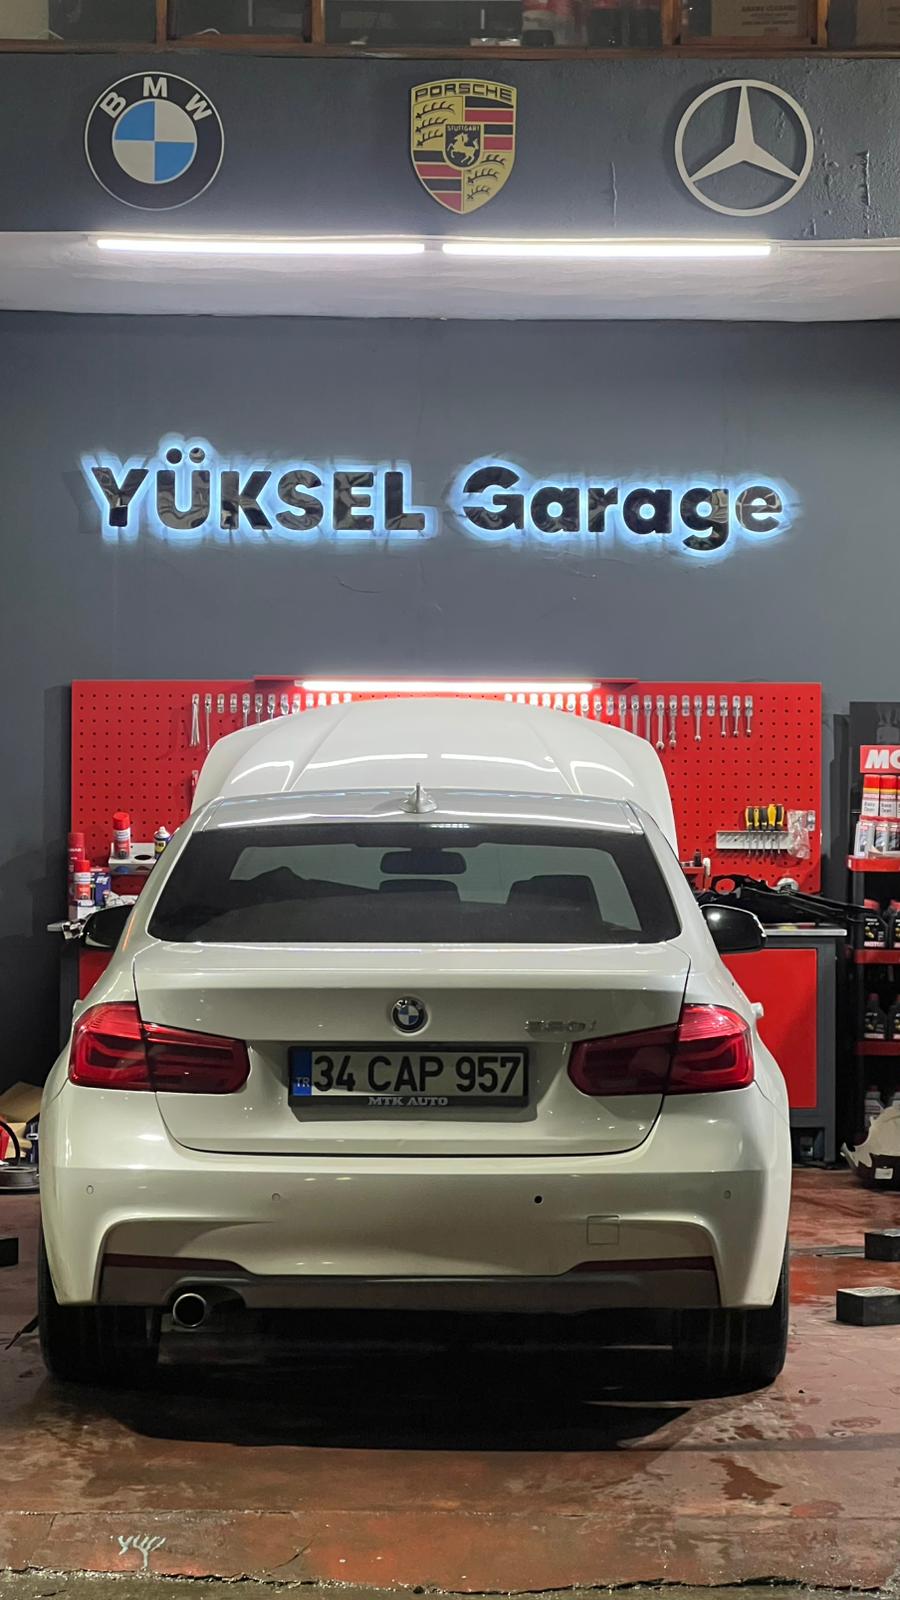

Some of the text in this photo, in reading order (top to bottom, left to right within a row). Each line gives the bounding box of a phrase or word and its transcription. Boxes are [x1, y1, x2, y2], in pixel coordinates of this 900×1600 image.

[100, 76, 213, 121] BMW
[415, 83, 512, 102] PORSCHE
[91, 447, 784, 551] YÜKSEL Garage
[296, 1076, 311, 1088] TR
[313, 1055, 521, 1093] 34 CAP 957
[368, 1096, 449, 1106] MTK AUTO
